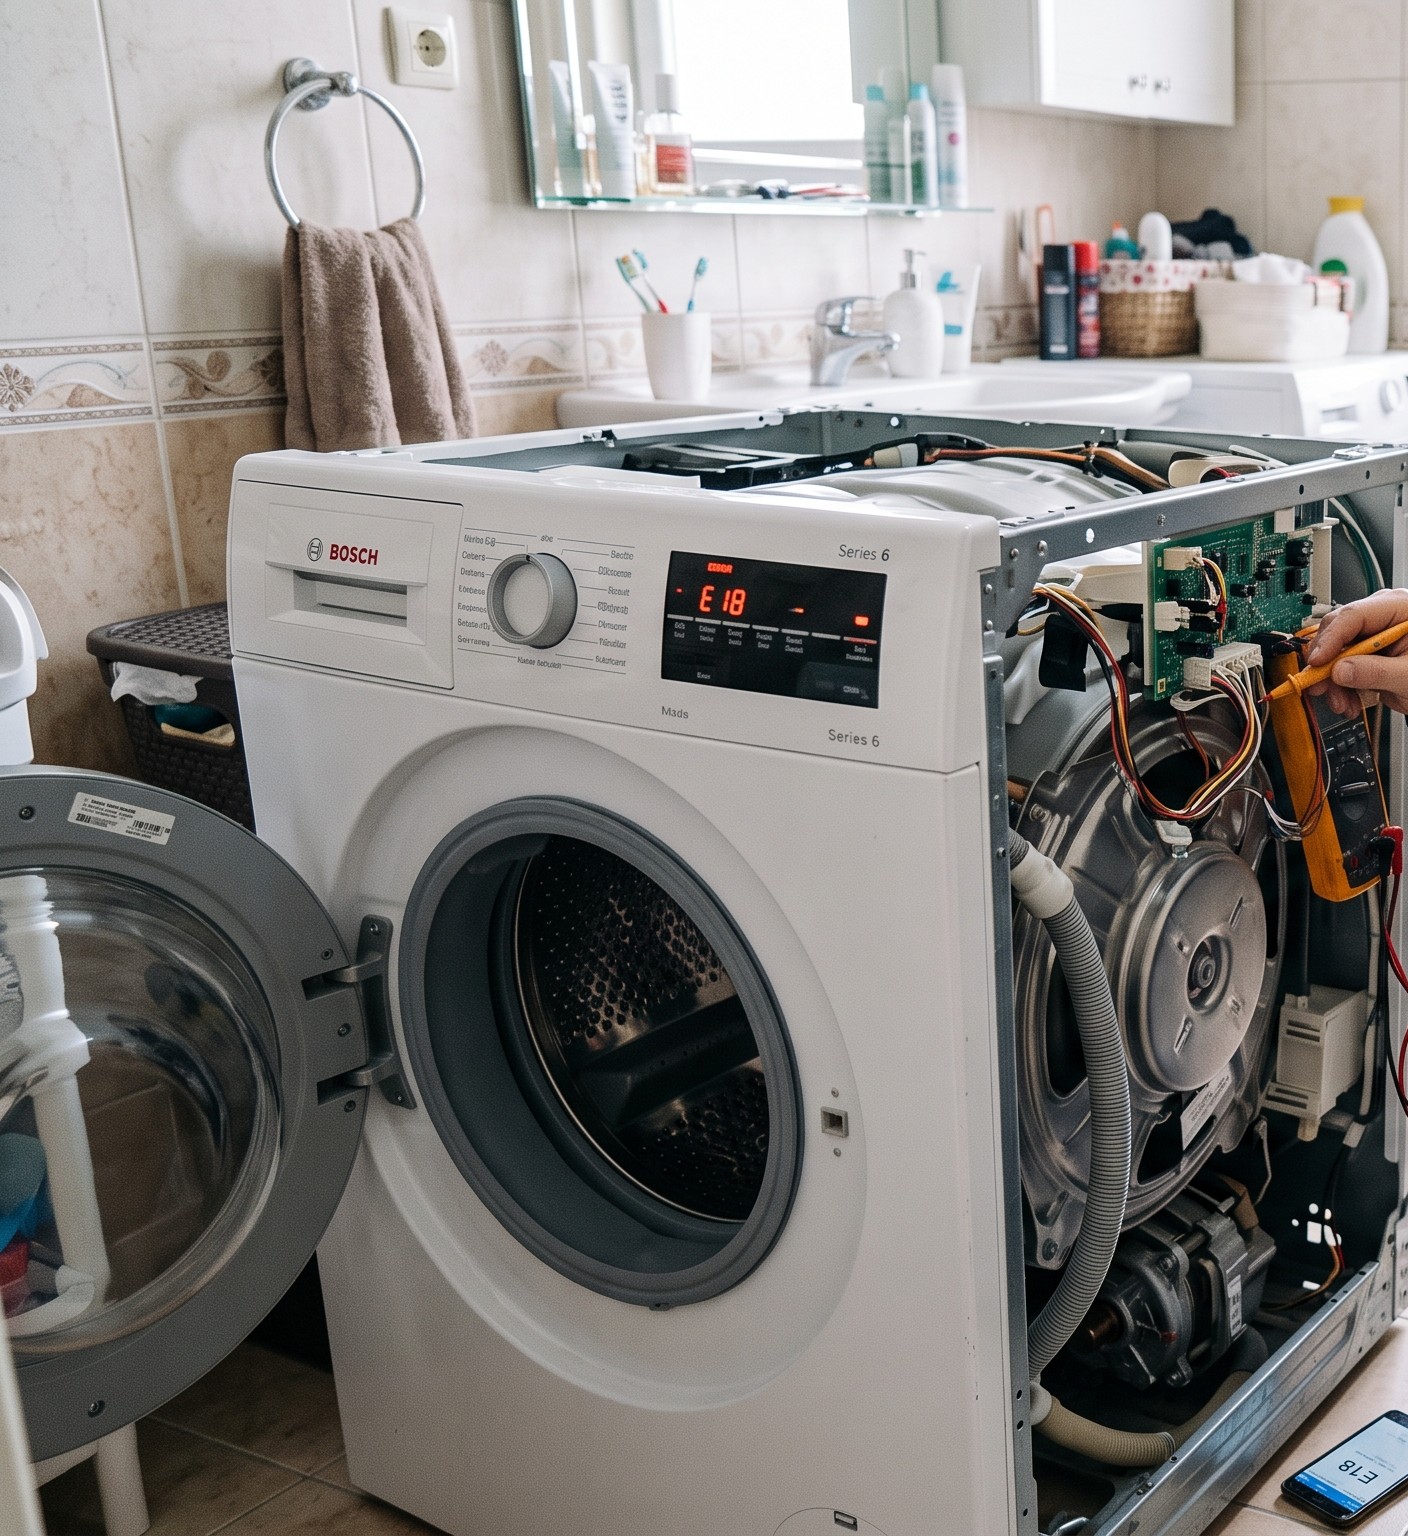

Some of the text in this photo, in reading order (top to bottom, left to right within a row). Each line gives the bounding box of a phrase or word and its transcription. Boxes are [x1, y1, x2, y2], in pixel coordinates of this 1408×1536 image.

[329, 543, 379, 566] BOSCH
[838, 544, 890, 562] Series 6
[699, 585, 747, 616] E18
[828, 728, 880, 748] Series 6
[1338, 1459, 1379, 1485] E18
